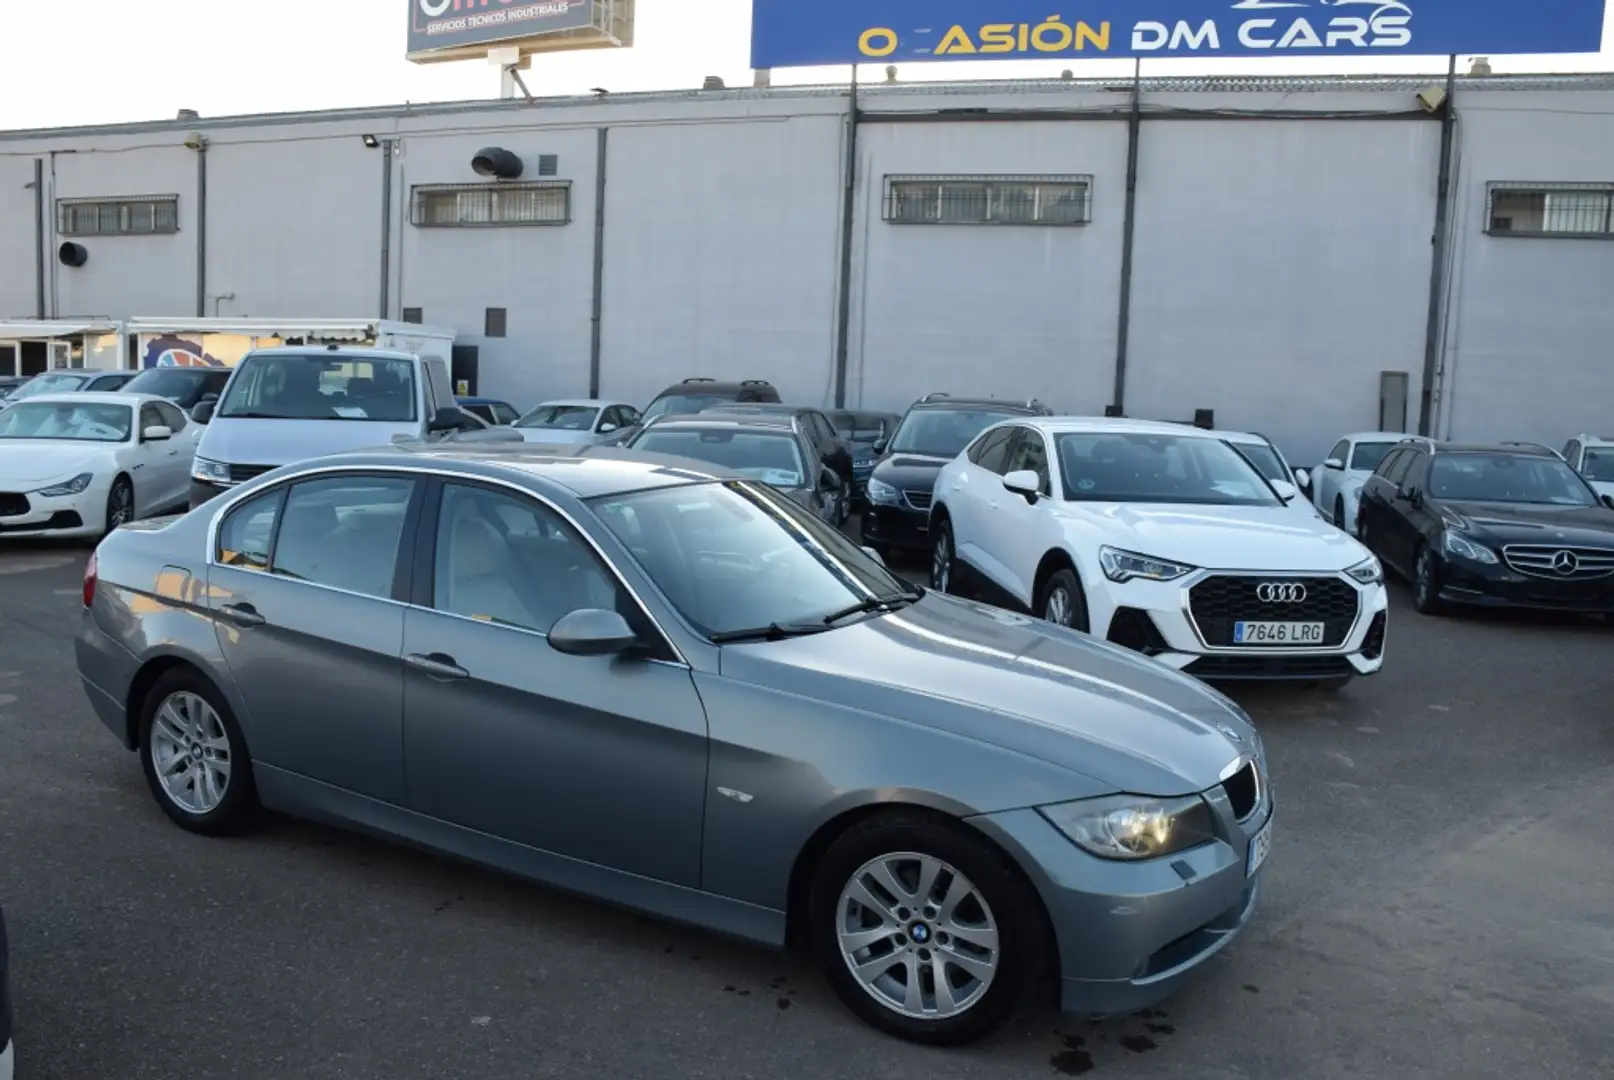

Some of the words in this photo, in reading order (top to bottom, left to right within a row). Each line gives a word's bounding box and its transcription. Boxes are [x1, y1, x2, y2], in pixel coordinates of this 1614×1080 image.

[1131, 19, 1220, 50] DM
[1237, 16, 1412, 48] CARS
[1246, 624, 1287, 641] 7646
[1291, 624, 1321, 641] LRG
